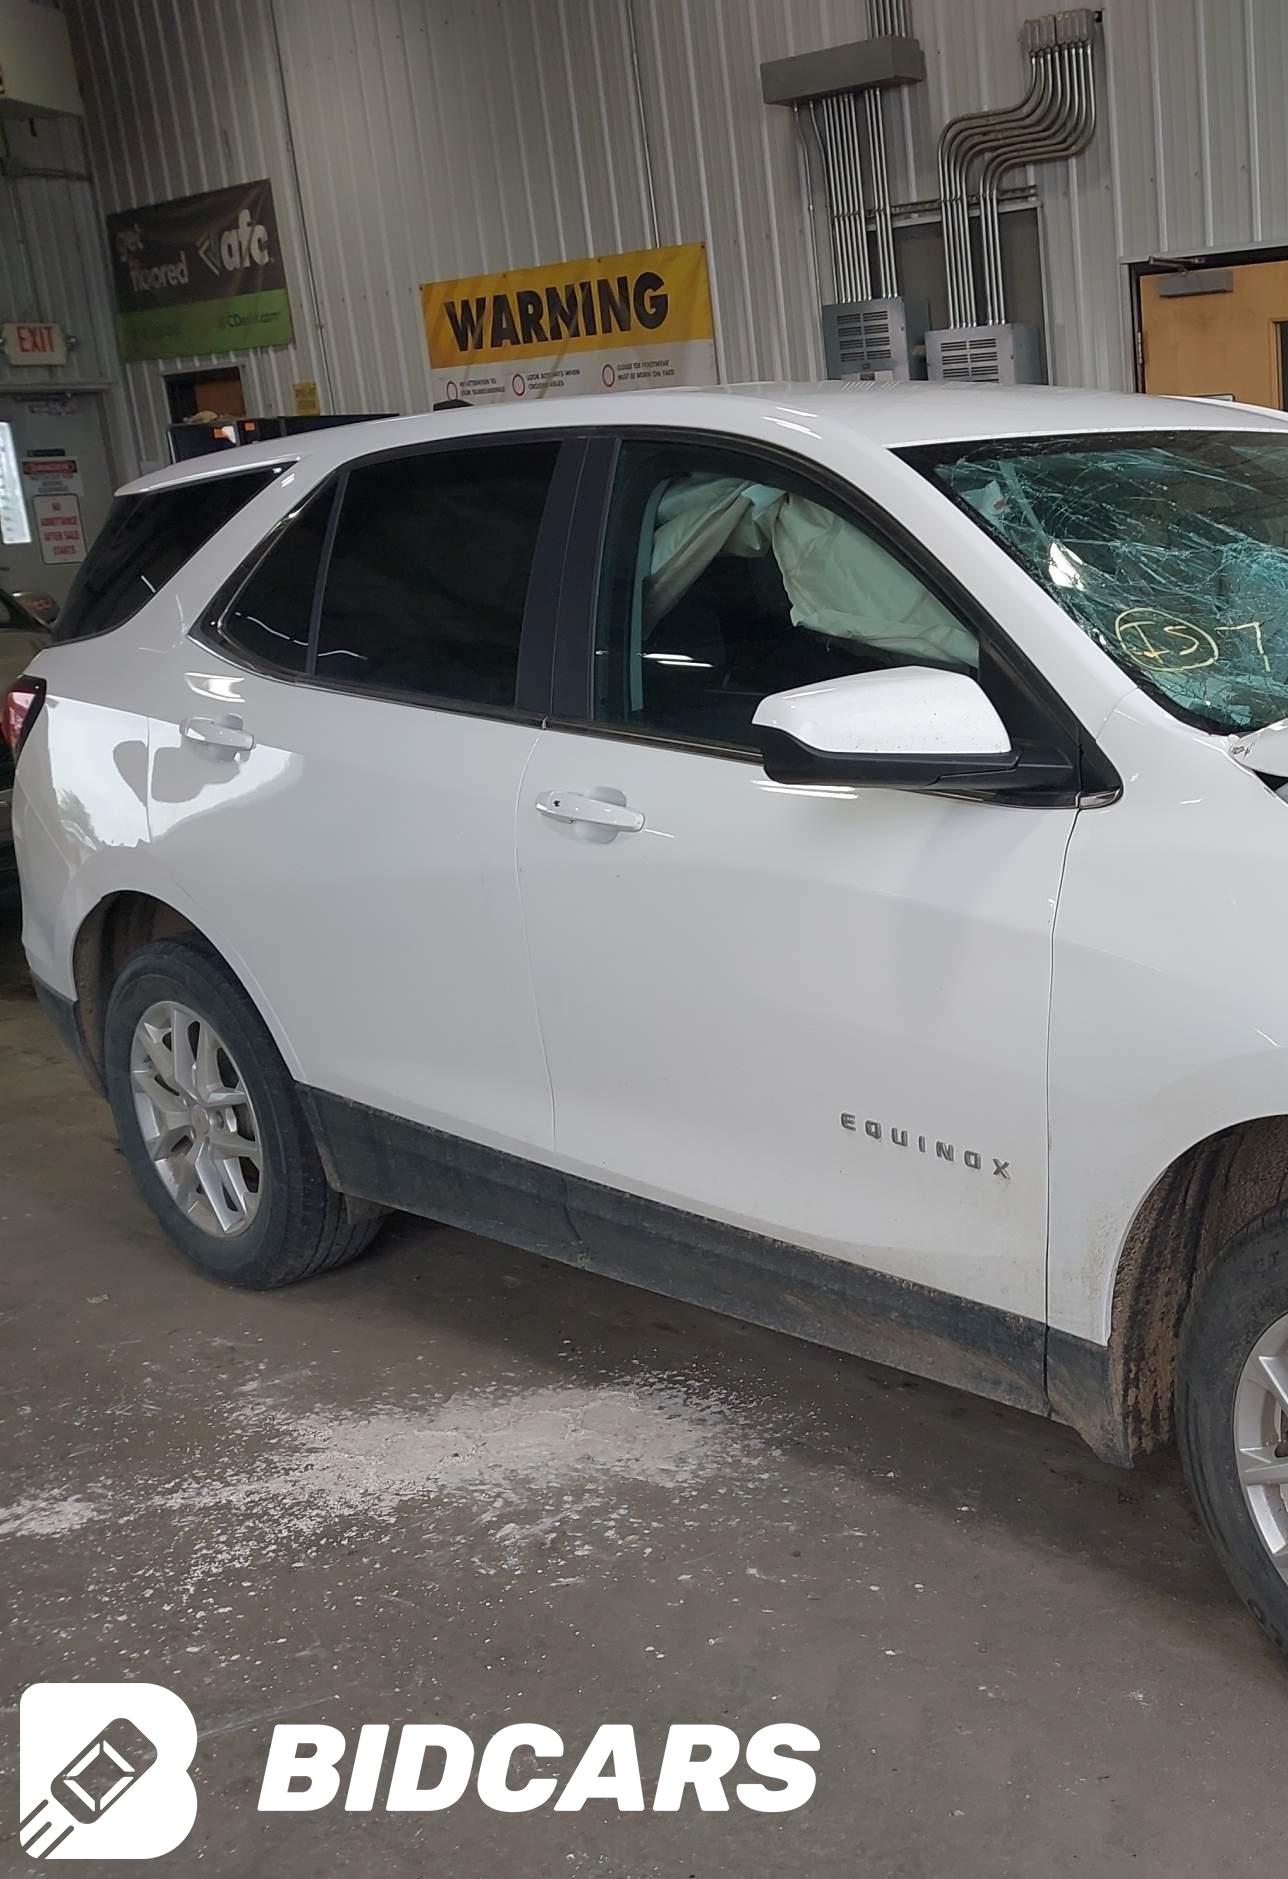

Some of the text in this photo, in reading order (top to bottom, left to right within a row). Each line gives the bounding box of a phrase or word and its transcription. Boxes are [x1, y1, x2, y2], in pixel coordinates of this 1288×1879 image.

[220, 208, 270, 271] afc
[16, 326, 55, 352] EXIT
[444, 272, 669, 352] WARNING
[841, 1112, 1011, 1180] EQUINOX
